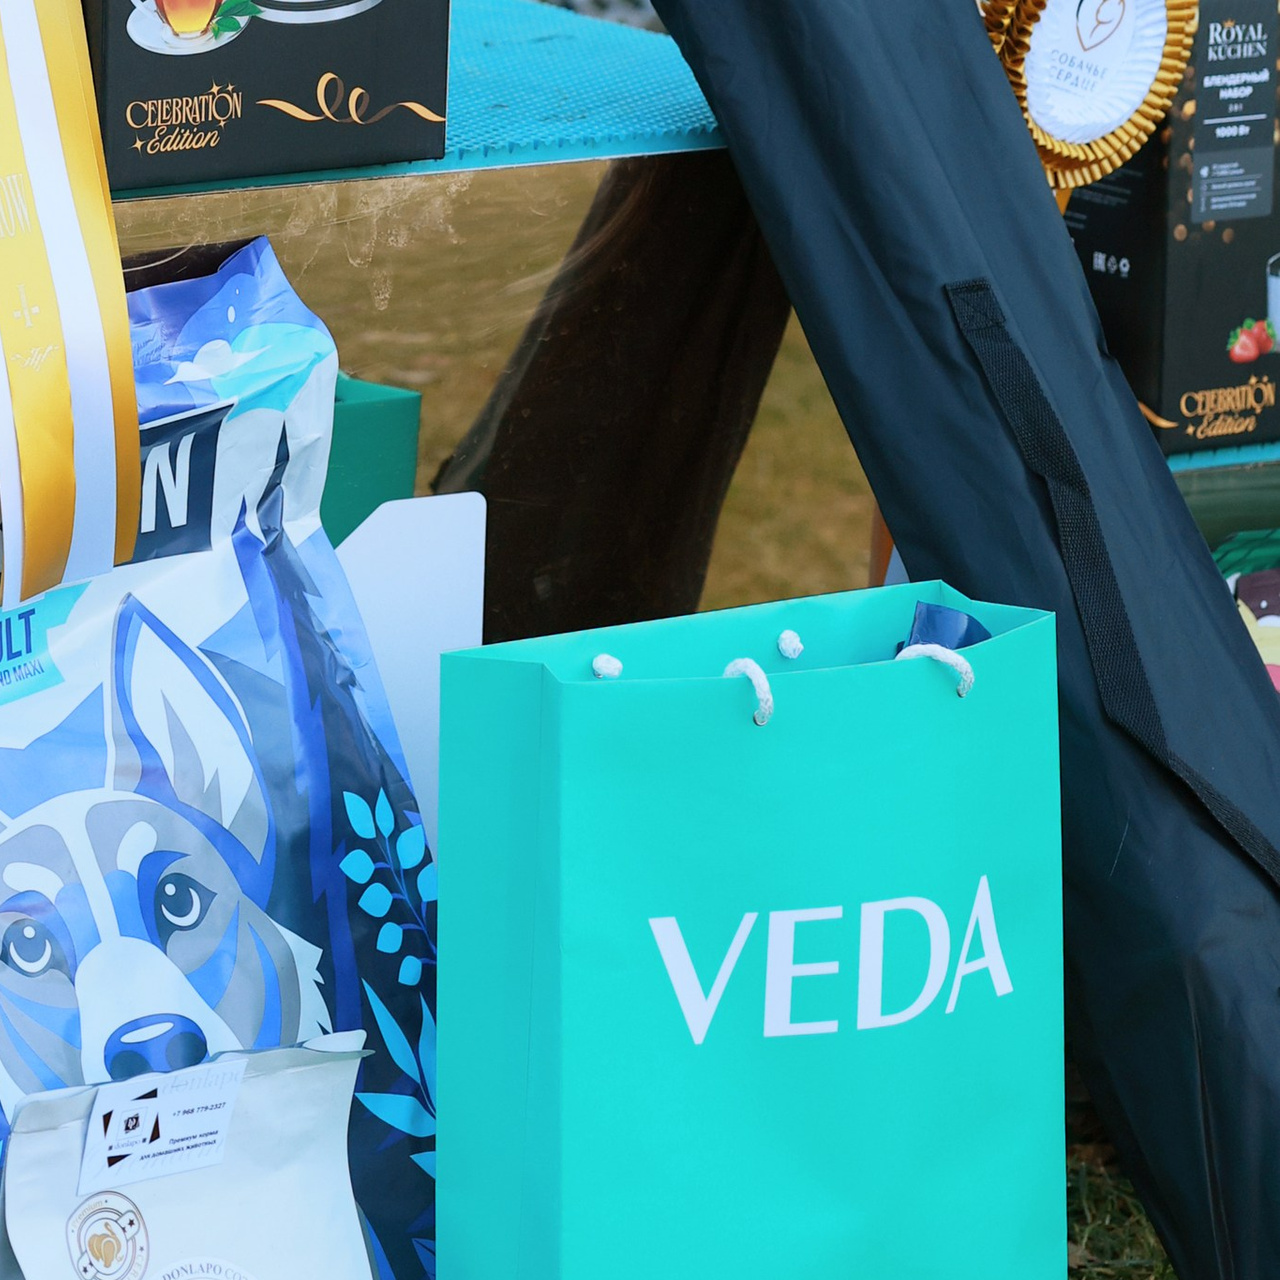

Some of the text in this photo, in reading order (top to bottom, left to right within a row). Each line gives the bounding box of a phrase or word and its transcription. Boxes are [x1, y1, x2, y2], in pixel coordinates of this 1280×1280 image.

[1208, 22, 1268, 45] ROYAL
[125, 91, 243, 128] CELEBRATION
[146, 125, 221, 154] Edition
[1180, 382, 1276, 418] CELEBRATION
[1196, 412, 1257, 439] Edition
[12, 658, 45, 682] MAXI
[648, 874, 1014, 1045] VEDA
